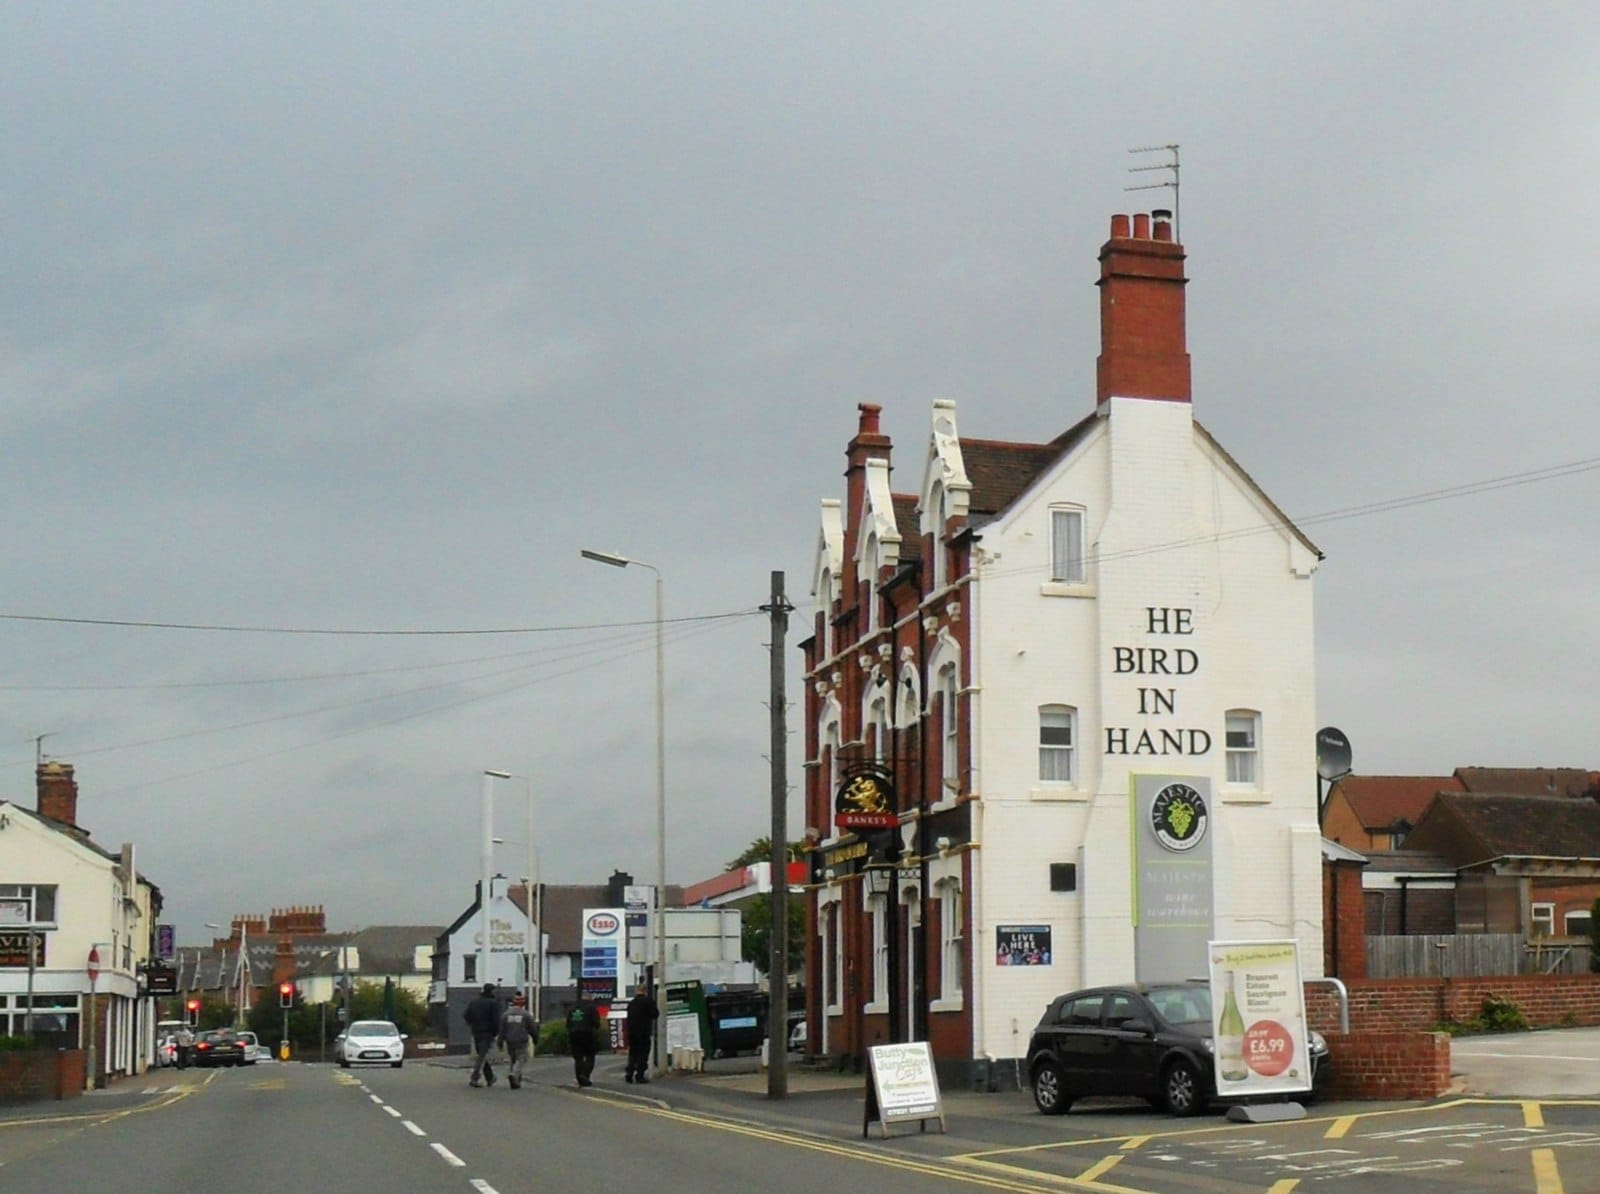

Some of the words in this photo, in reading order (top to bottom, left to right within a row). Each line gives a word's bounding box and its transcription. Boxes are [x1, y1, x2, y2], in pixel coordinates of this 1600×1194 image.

[1146, 607, 1194, 635] HE
[1113, 647, 1199, 675] BIRD
[1137, 688, 1177, 715] IN
[1104, 728, 1212, 755] HAND
[1153, 786, 1204, 824] MAJESTIC
[847, 816, 888, 825] BANKS'S
[592, 919, 615, 929] Esso
[1011, 933, 1034, 942] LIVE
[875, 1047, 906, 1059] Butty
[1250, 1038, 1286, 1054] £6.99
[878, 1058, 929, 1072] Junction
